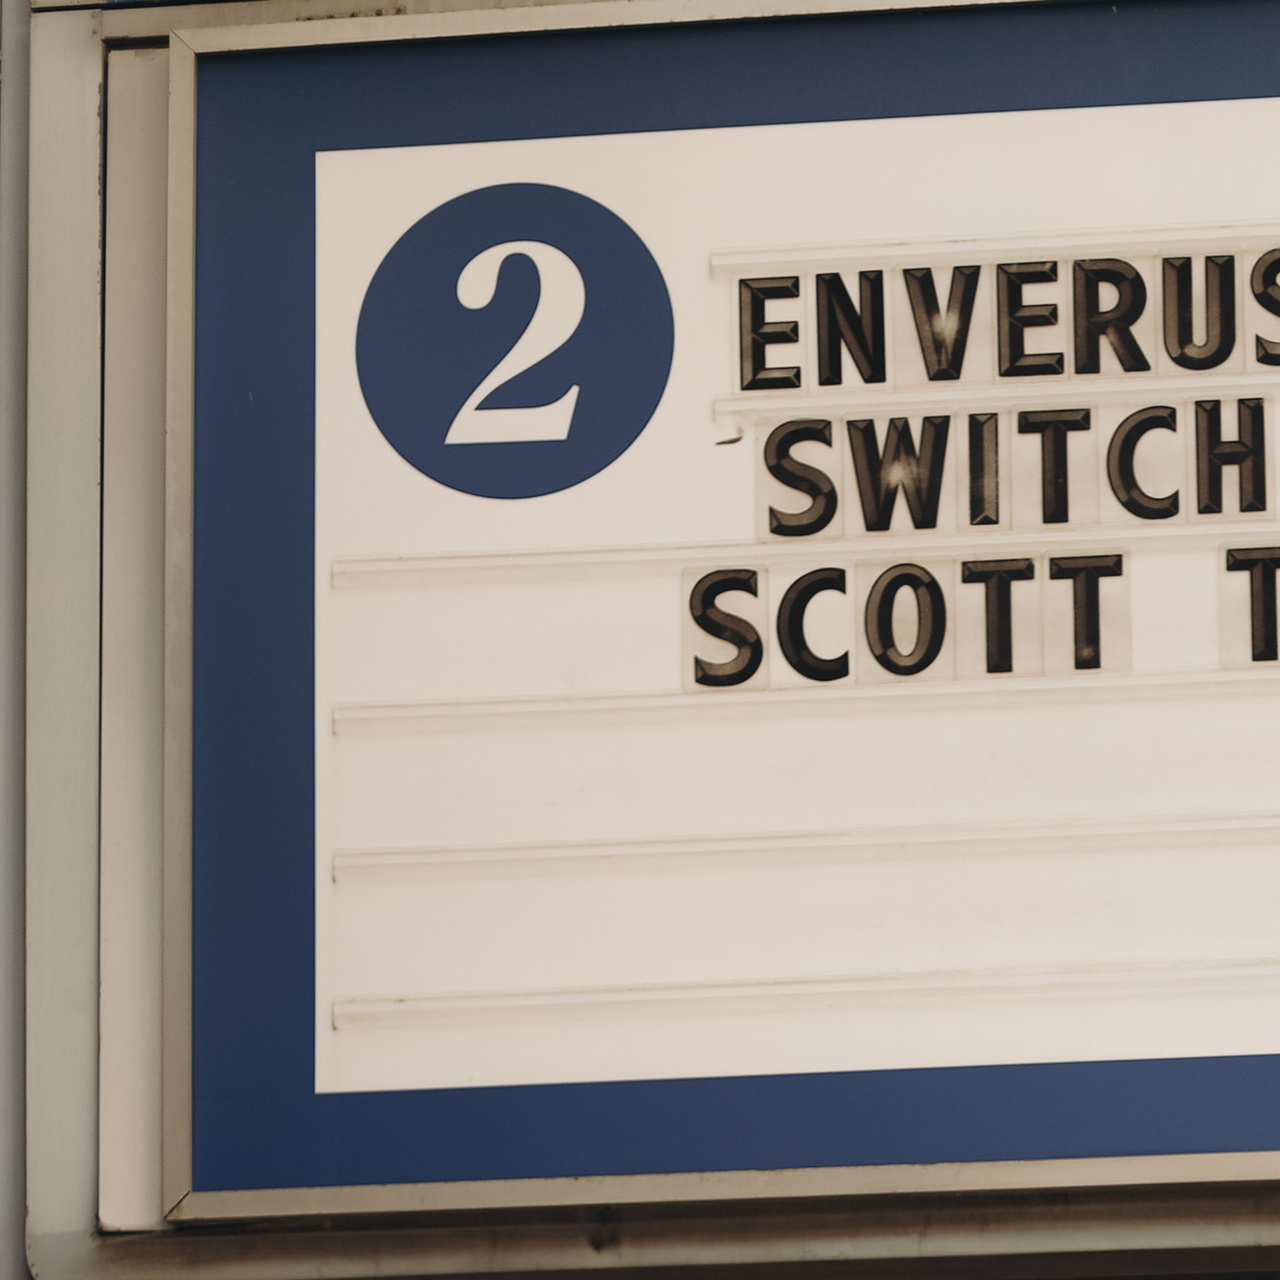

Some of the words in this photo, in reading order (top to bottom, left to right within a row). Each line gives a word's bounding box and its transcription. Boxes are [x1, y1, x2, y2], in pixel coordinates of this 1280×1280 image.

[444, 239, 586, 445] 2
[763, 397, 1268, 538] SWITCH
[688, 553, 1125, 688] SCOTT
